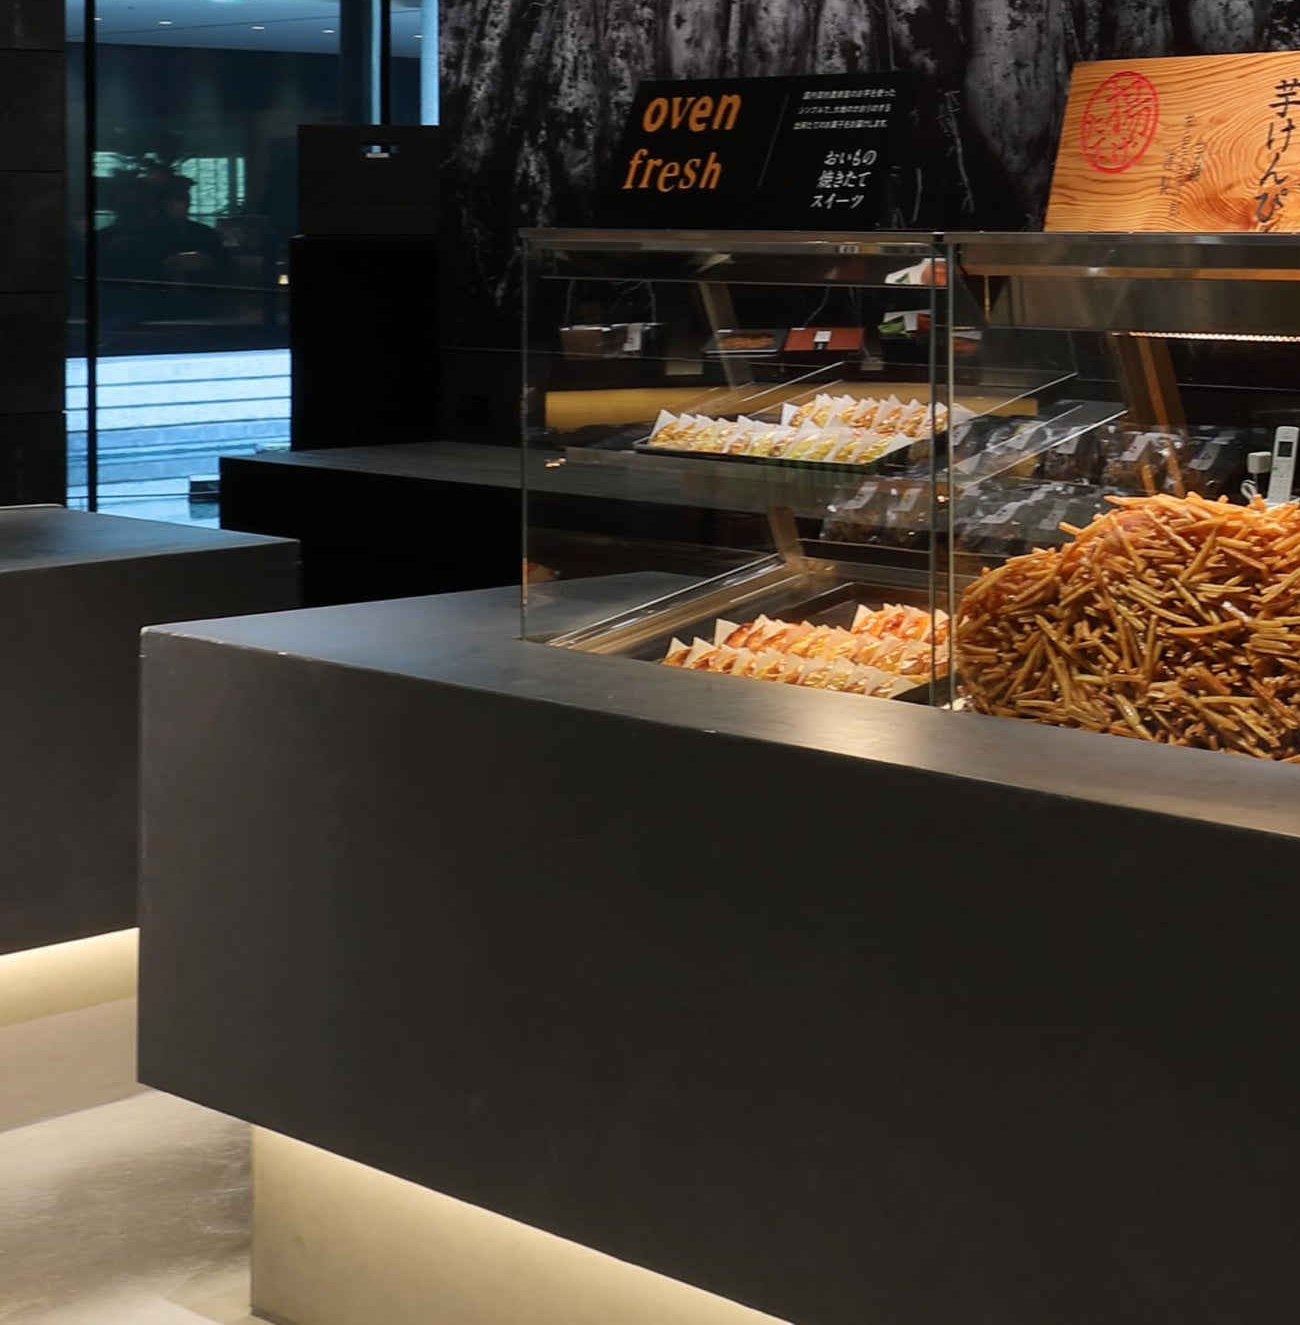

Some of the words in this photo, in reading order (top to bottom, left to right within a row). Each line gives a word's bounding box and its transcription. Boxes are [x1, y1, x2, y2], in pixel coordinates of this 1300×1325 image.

[642, 93, 742, 133] oven
[622, 148, 722, 193] fresh
[816, 170, 872, 188] 焼きたて
[810, 193, 864, 209] スイーツ
